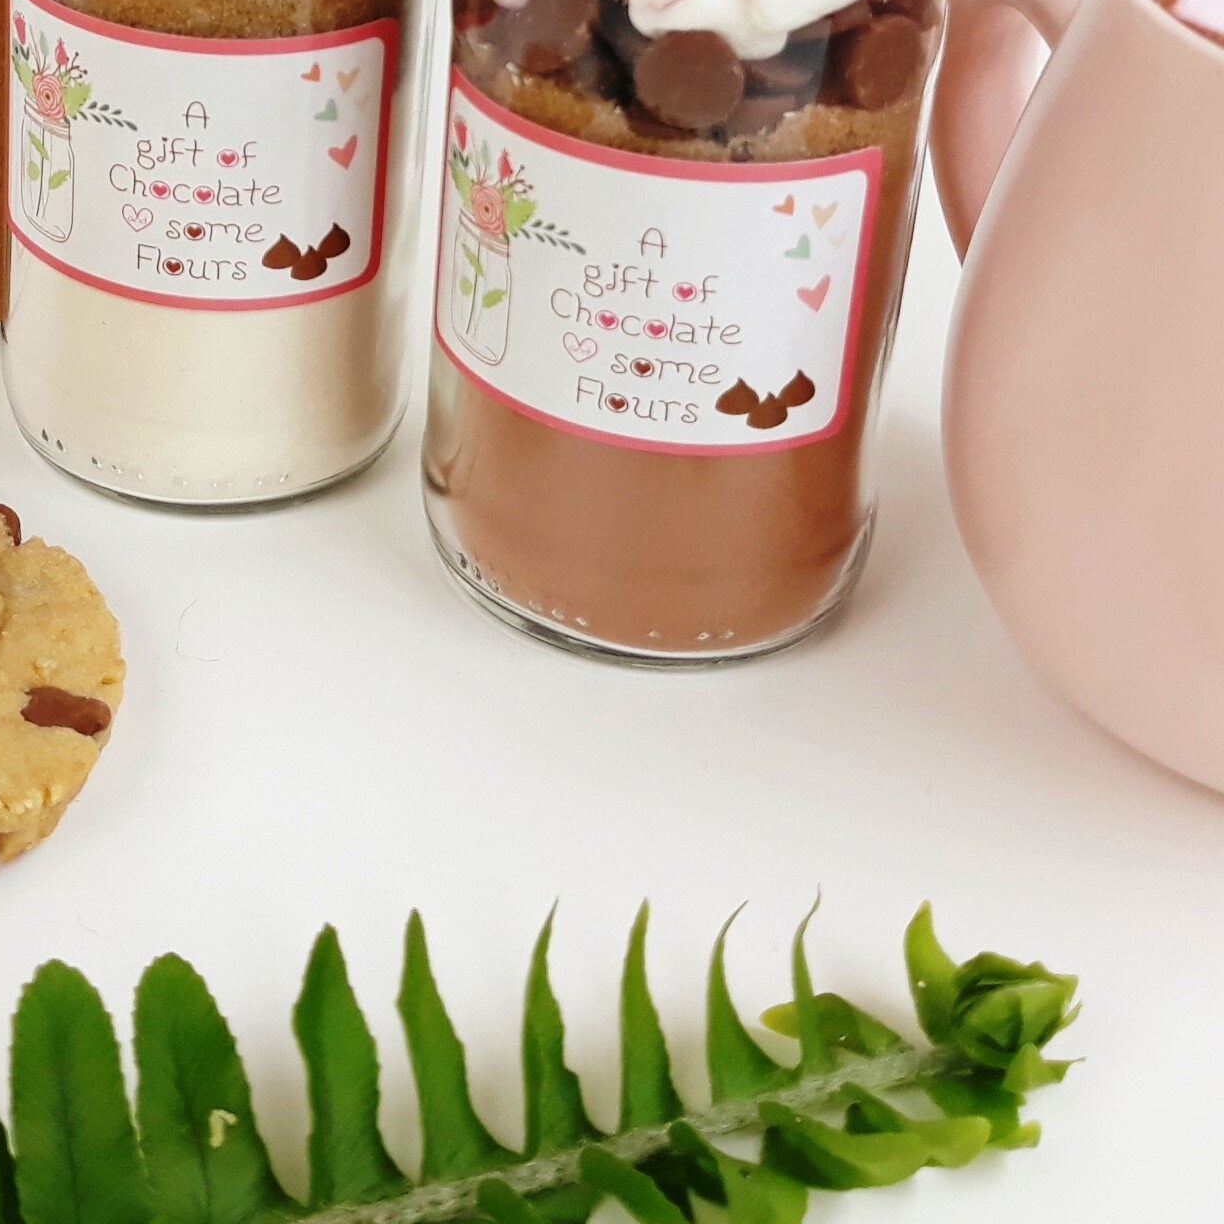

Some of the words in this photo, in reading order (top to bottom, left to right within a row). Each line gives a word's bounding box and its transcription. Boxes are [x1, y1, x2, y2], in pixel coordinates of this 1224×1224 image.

[182, 101, 210, 129] A
[136, 137, 204, 170] gift
[216, 142, 257, 168] of
[109, 164, 282, 206] Chocolate
[166, 220, 265, 243] some
[637, 227, 668, 258] A
[136, 244, 248, 280] Flours
[583, 264, 658, 298] gift
[672, 275, 719, 303] of
[550, 288, 743, 345] Chocolate
[610, 353, 721, 384] some
[576, 376, 699, 424] Flours
